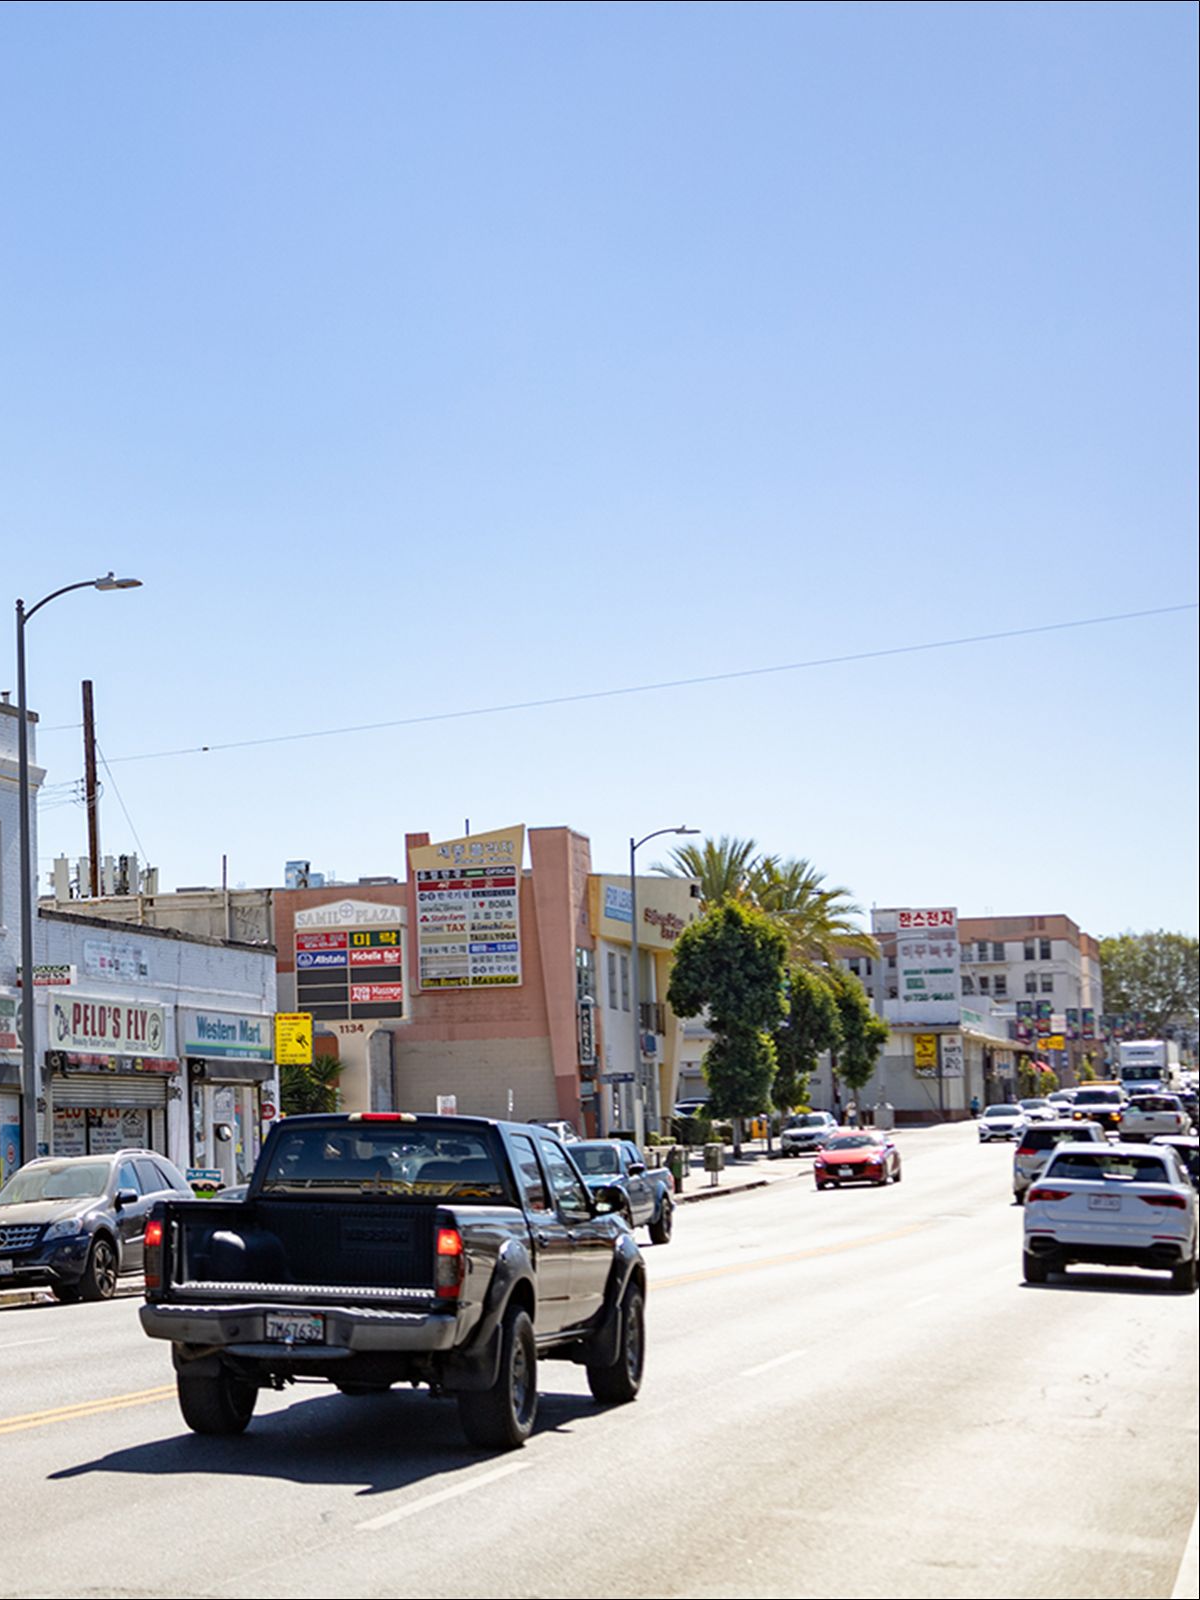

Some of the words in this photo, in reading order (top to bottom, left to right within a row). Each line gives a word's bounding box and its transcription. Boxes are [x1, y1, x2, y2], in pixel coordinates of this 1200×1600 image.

[297, 910, 341, 926] SAMIL
[355, 908, 398, 923] PLAZA
[898, 910, 954, 928] 한스전자
[446, 923, 467, 933] TAX
[313, 954, 346, 965] Allstate
[351, 951, 382, 962] Michelle
[471, 976, 519, 985] MASSAGE
[371, 986, 403, 997] Massage
[72, 1002, 121, 1039] PELO'S
[127, 1009, 148, 1041] FLY
[196, 1015, 237, 1042] Western
[239, 1020, 262, 1045] Mart
[338, 1023, 365, 1034] 1134
[580, 1009, 591, 1061] PARKING
[186, 1171, 204, 1180] PLAY
[206, 1171, 221, 1180] NOW
